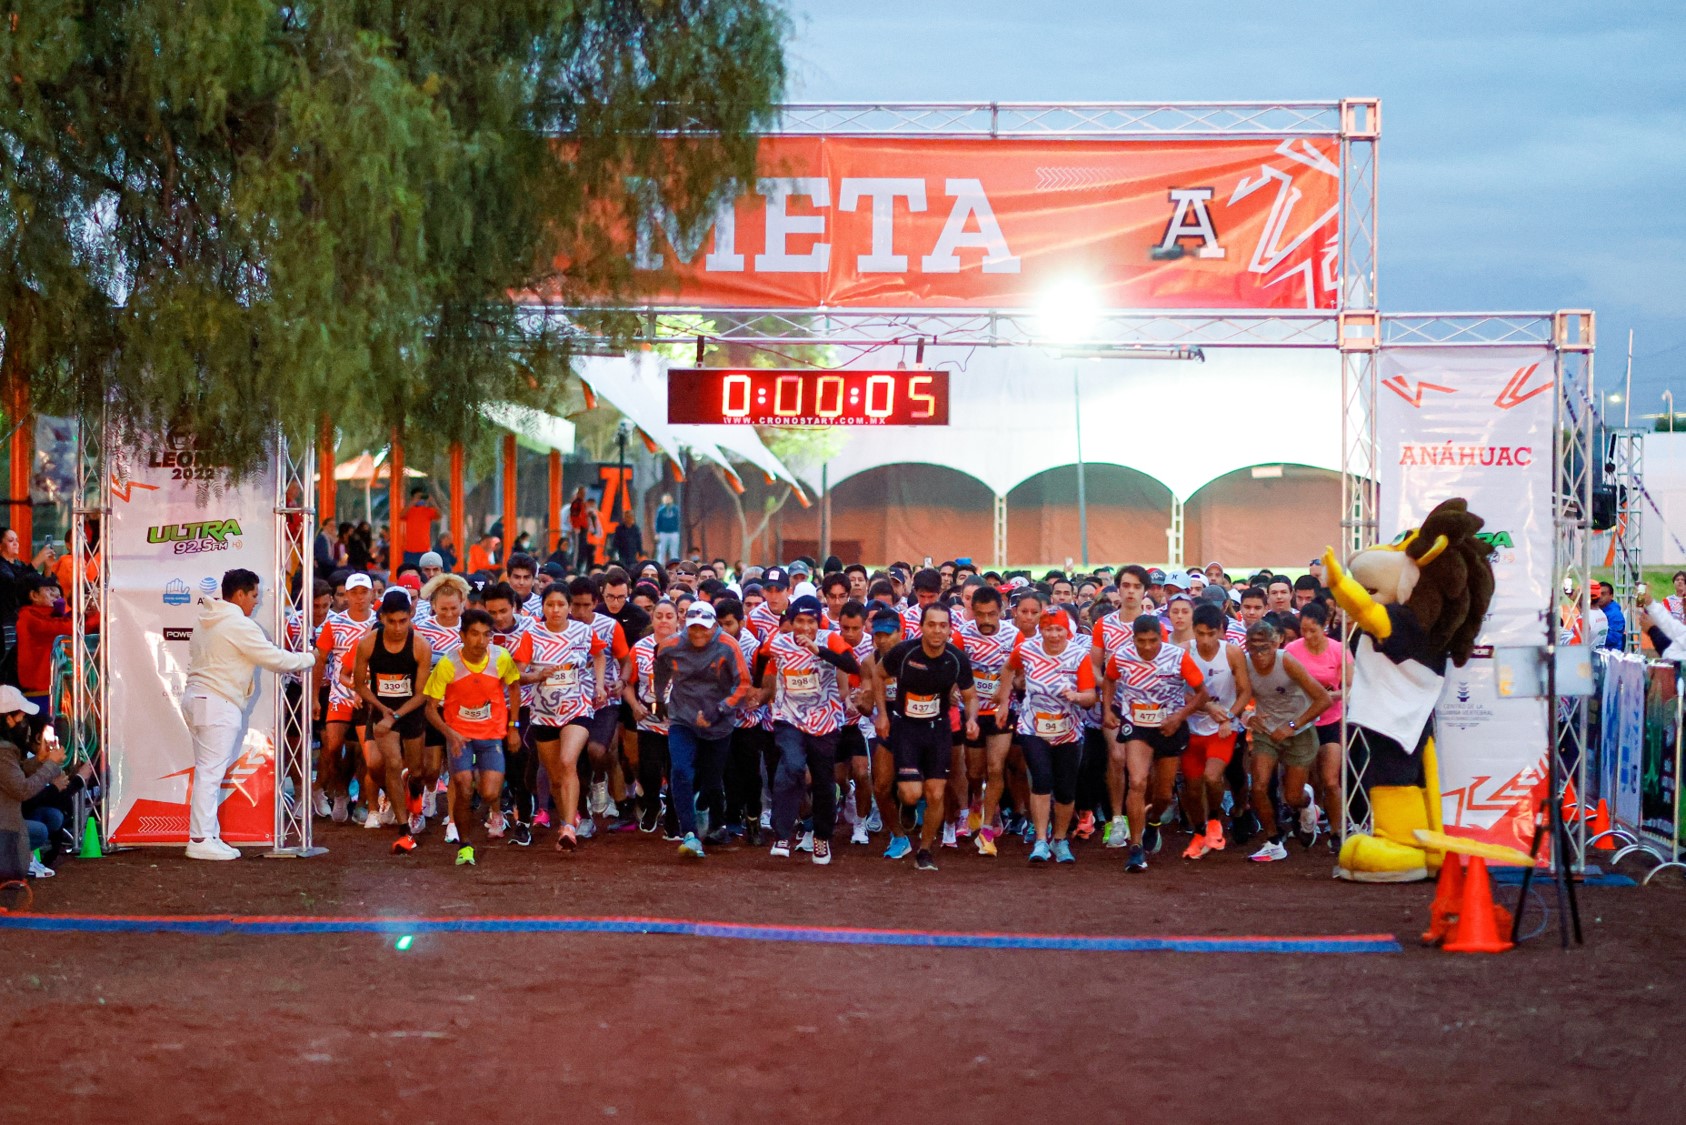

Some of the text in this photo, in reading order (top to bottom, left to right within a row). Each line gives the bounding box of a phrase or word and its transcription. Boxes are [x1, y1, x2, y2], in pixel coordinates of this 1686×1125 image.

[624, 176, 1020, 274] META
[722, 375, 935, 418] 0:00:05
[1399, 440, 1533, 466] ANÁHUAC
[171, 468, 215, 480] 2022
[147, 519, 242, 544] ULTRA
[791, 678, 808, 686] 298
[977, 682, 993, 690] 508
